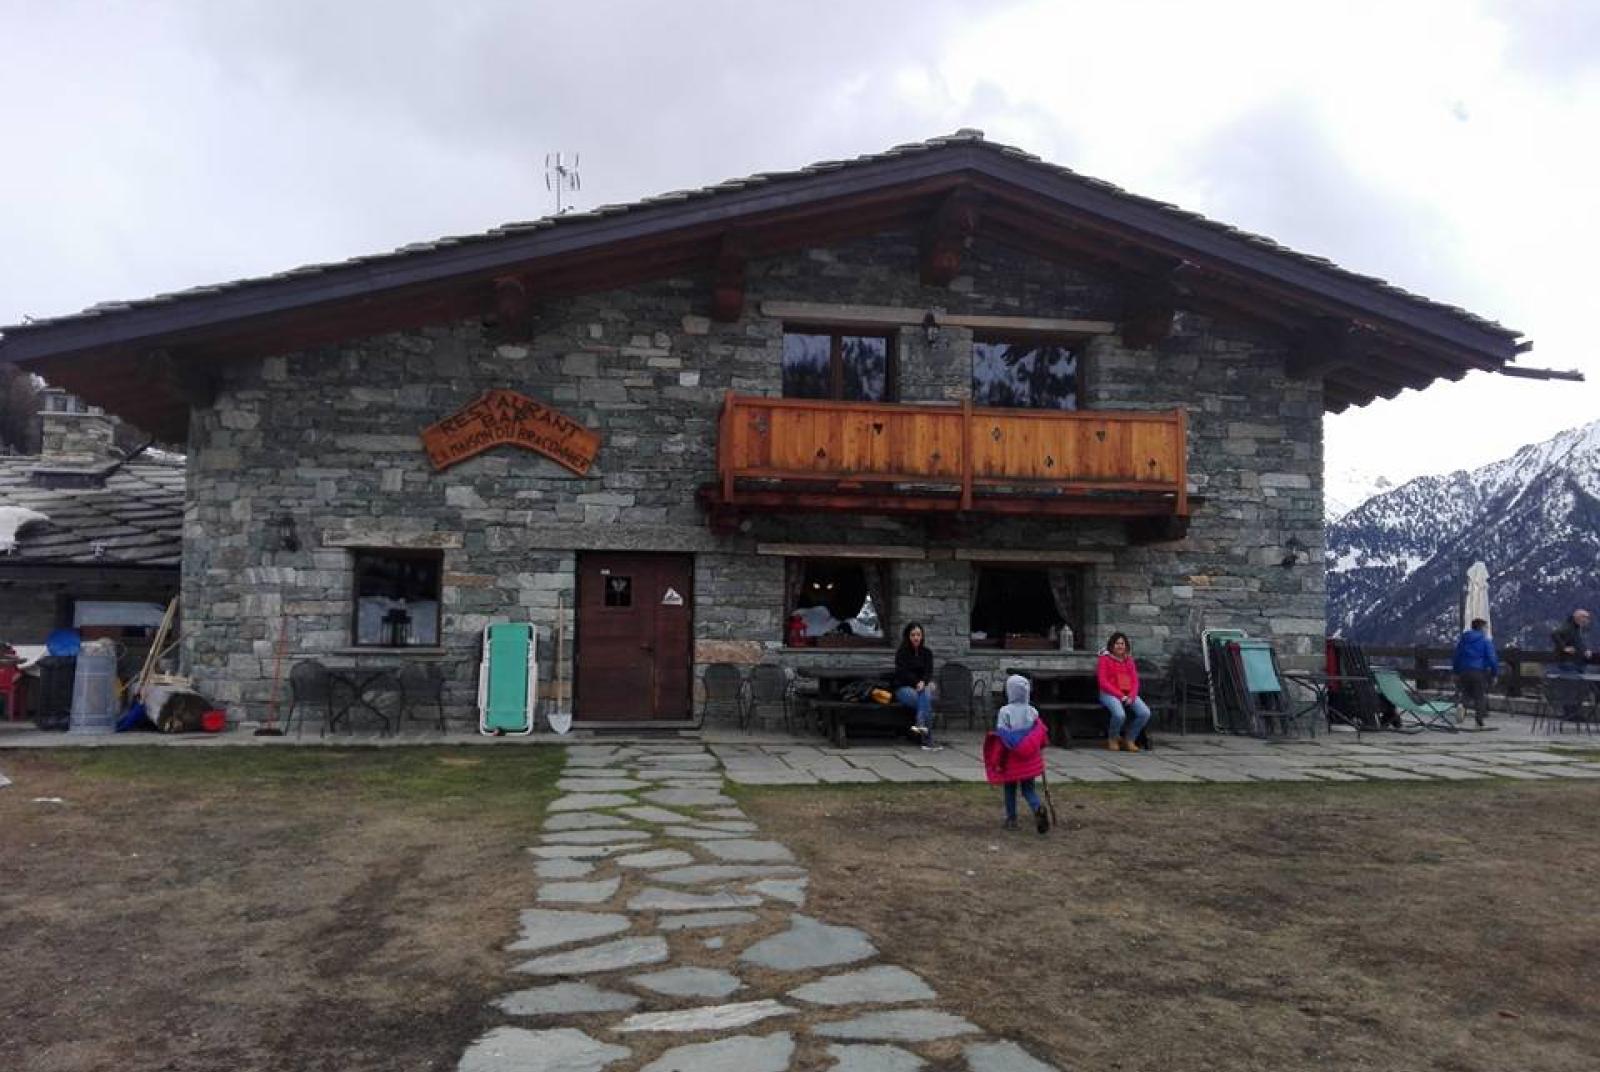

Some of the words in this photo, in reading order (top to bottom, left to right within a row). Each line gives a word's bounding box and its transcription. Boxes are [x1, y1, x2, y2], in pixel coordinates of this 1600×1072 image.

[439, 393, 585, 441] RESTAURANT
[482, 409, 526, 429] BAR
[449, 430, 495, 457] MAISON
[495, 426, 515, 440] DU
